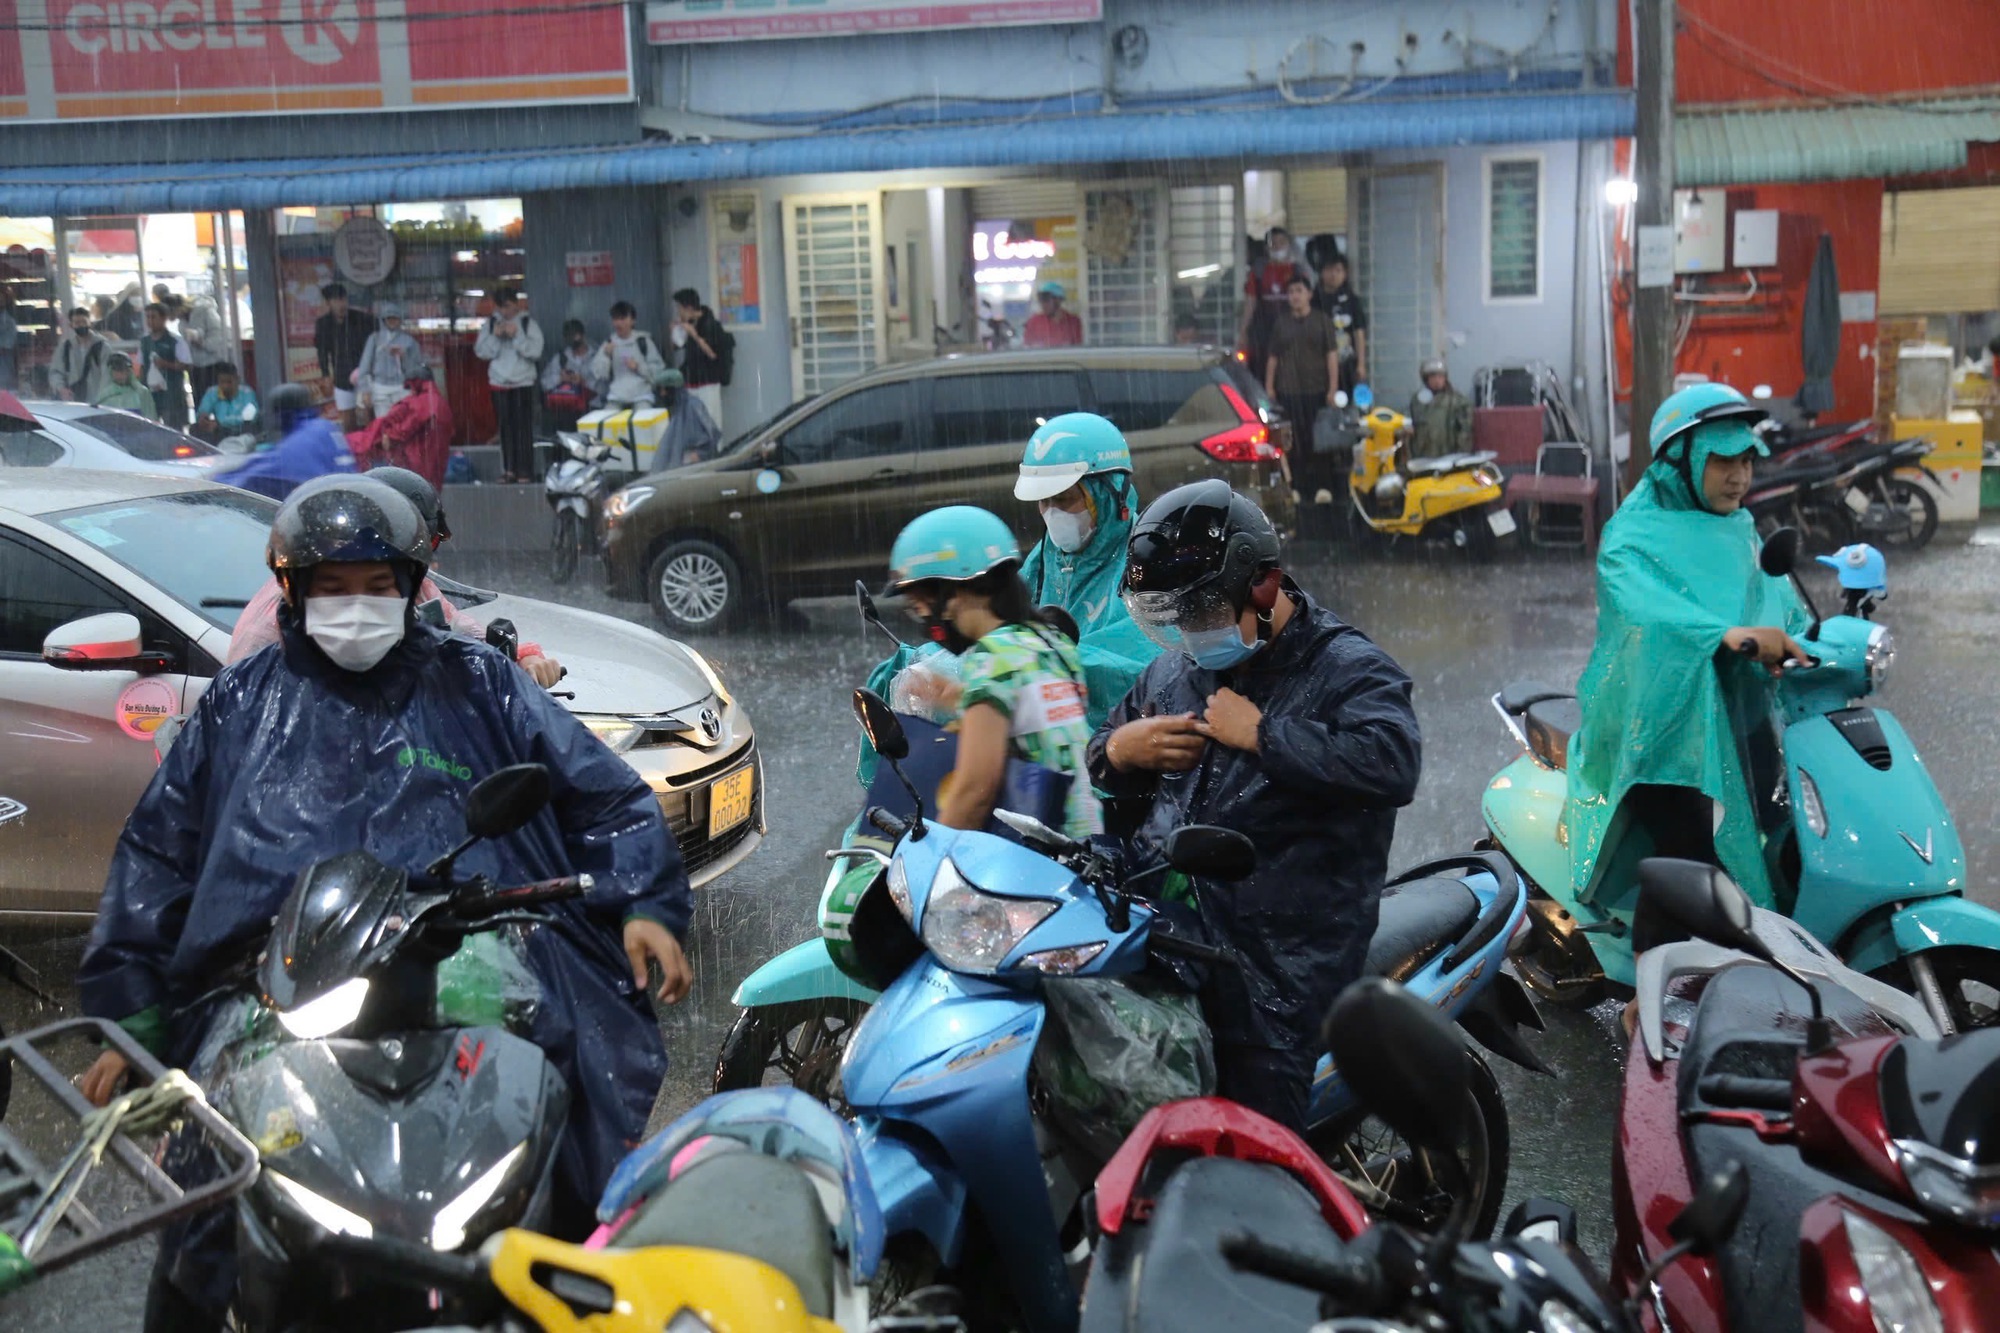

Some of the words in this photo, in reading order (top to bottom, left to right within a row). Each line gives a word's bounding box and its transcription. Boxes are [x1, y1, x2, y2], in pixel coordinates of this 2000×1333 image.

[64, 0, 267, 54] CIRCLE
[281, 0, 361, 65] K
[724, 773, 742, 802] 35E
[714, 796, 747, 832] 000.22
